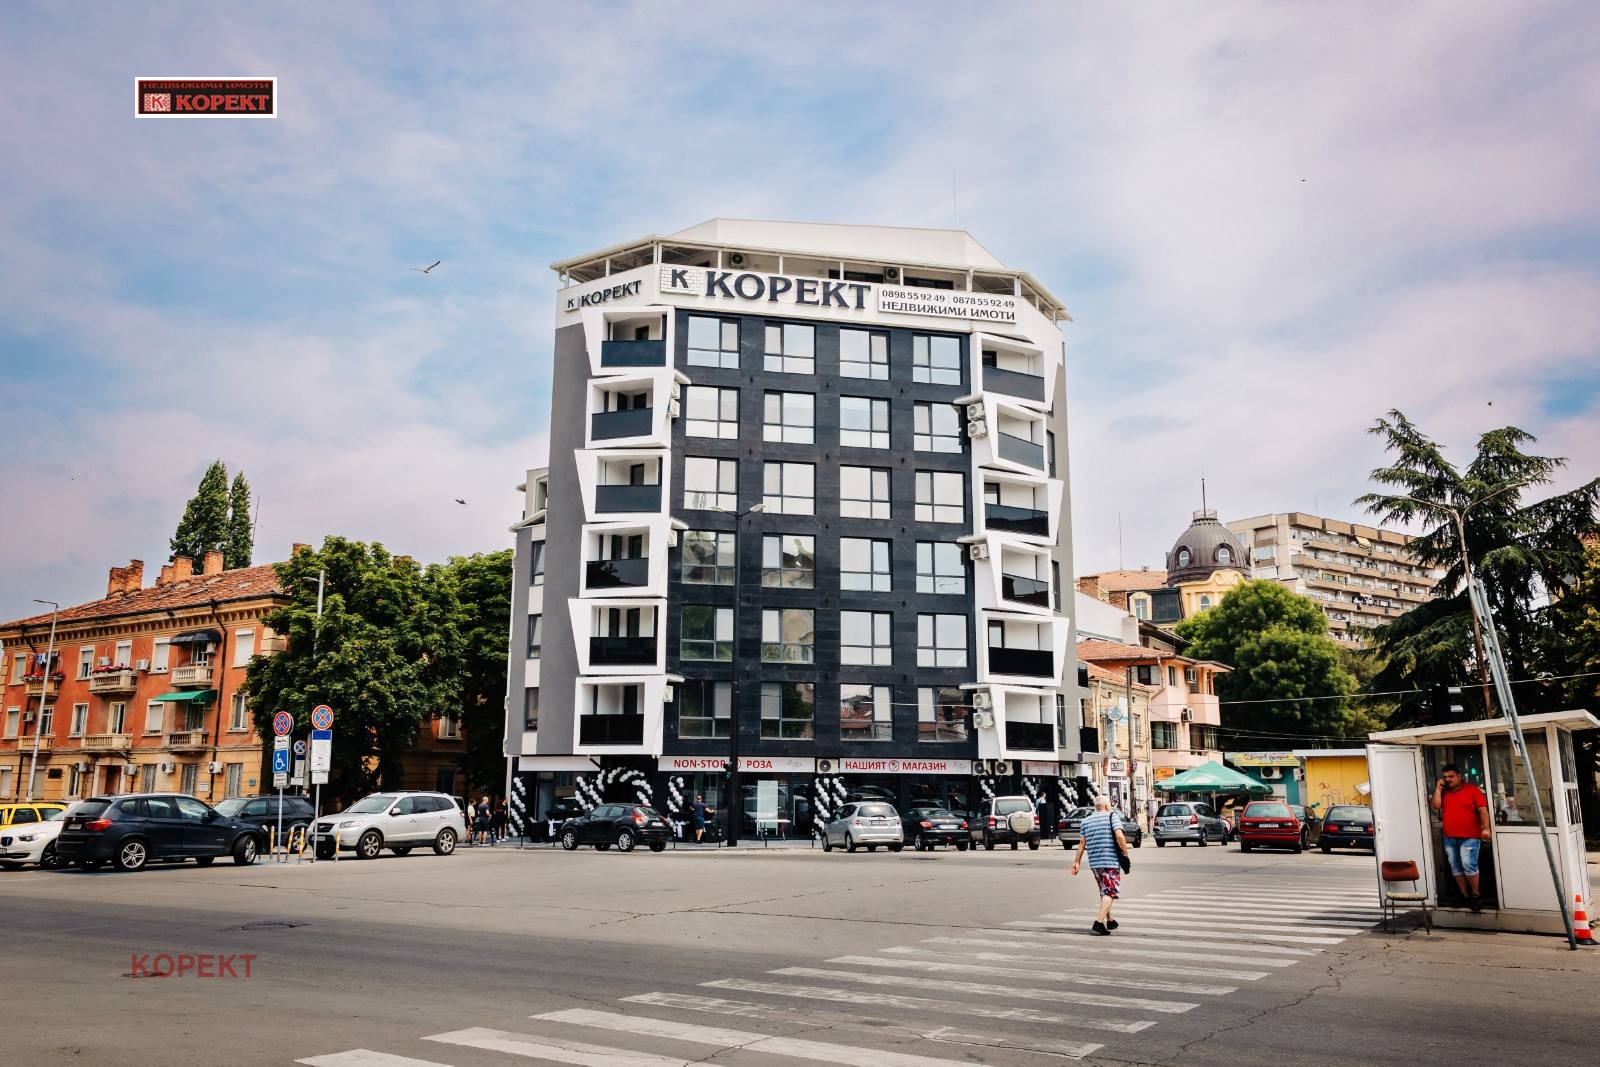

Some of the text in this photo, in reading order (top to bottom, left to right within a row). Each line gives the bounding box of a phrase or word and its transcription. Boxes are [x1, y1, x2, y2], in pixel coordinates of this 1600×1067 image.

[580, 279, 642, 307] КОРЕКТ
[671, 269, 872, 310] К КОРЕКТ
[882, 301, 1015, 320] НЕДВИЖИМИ ИМОТИ
[673, 759, 773, 769] NON-STOP РОЗА
[844, 760, 887, 770] НАШИЯТ
[901, 761, 947, 771] МАГАЗИН
